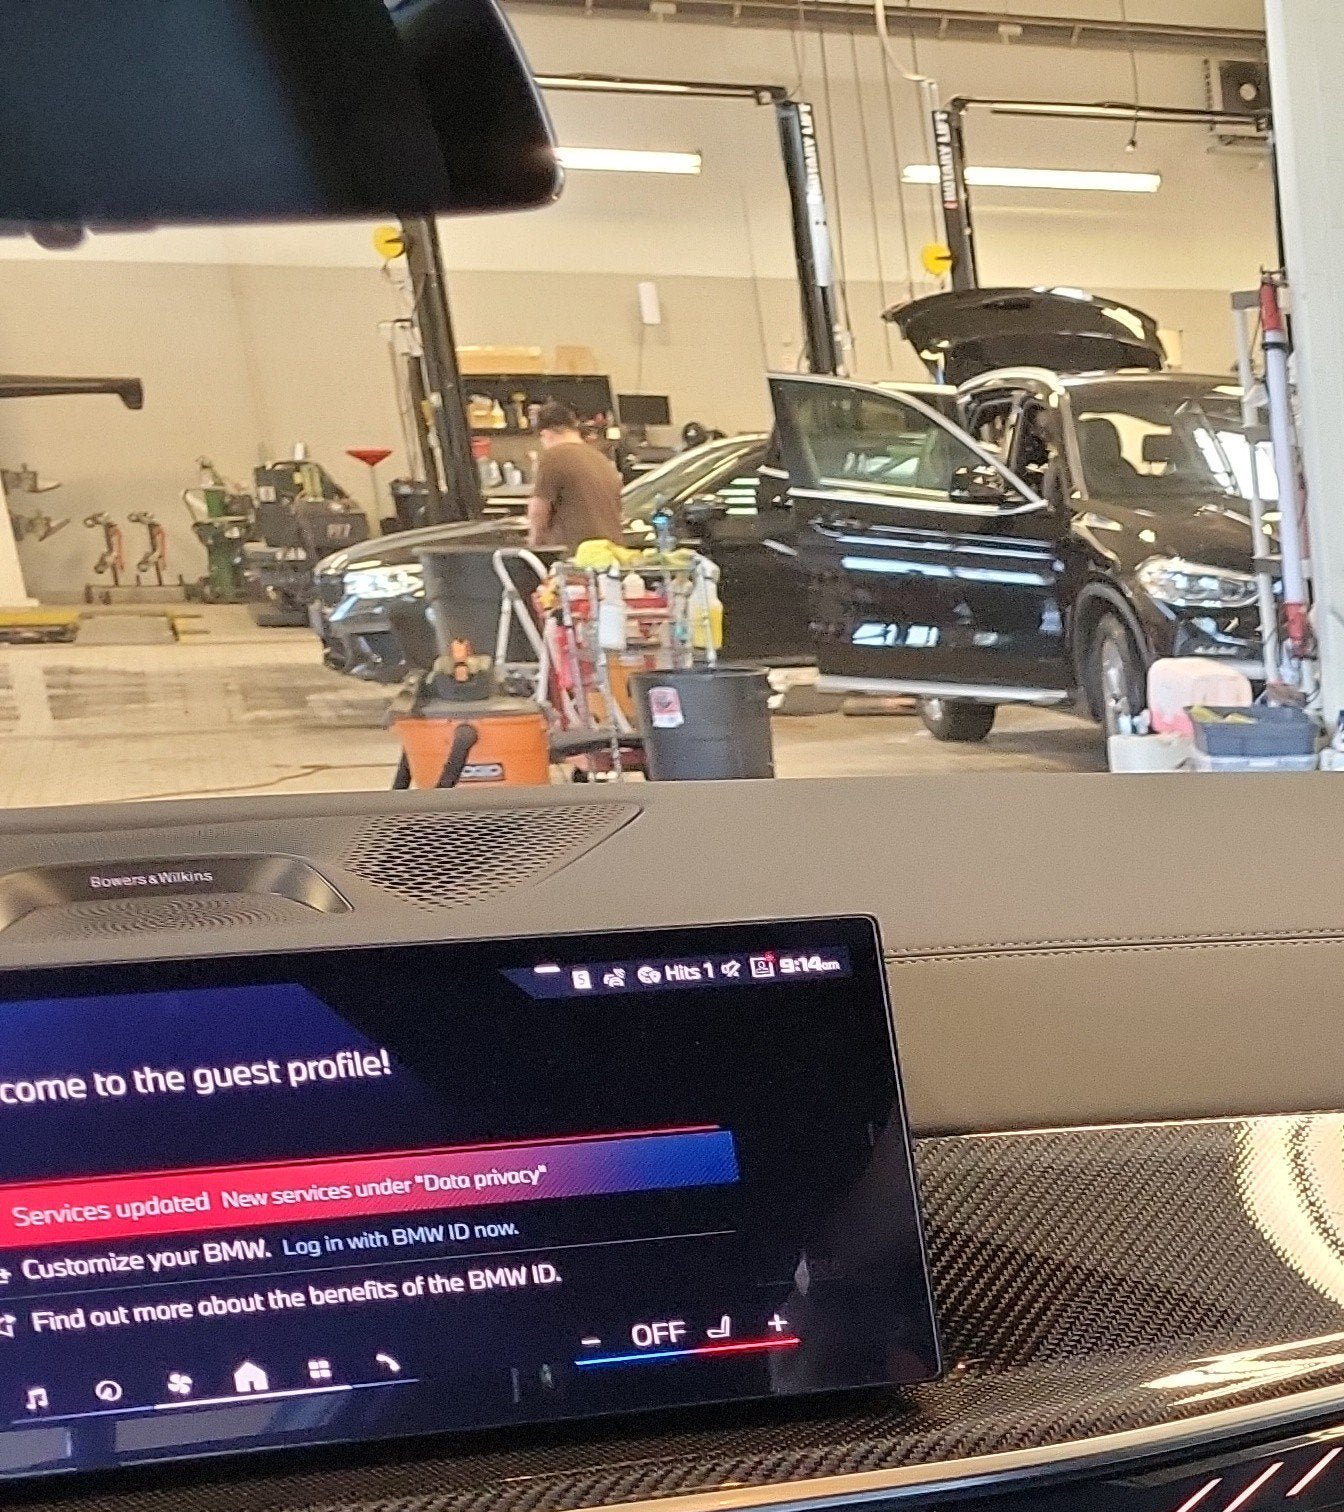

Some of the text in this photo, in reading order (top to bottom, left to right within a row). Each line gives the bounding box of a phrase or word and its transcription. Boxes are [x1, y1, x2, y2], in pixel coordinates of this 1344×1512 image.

[665, 963, 701, 981] Hits
[703, 962, 714, 979] 1
[94, 1073, 126, 1098] to
[133, 1066, 185, 1095] the
[193, 1060, 281, 1095] guest
[288, 1048, 392, 1087] profile!
[12, 1164, 547, 1228] Services updated New services under "Data privacy"
[22, 1220, 519, 1281] Customize your BMW. Log in with BMW ID now.
[32, 1263, 561, 1333] Find out more about the benefits of the BMW ID.
[631, 1321, 687, 1347] OFF
